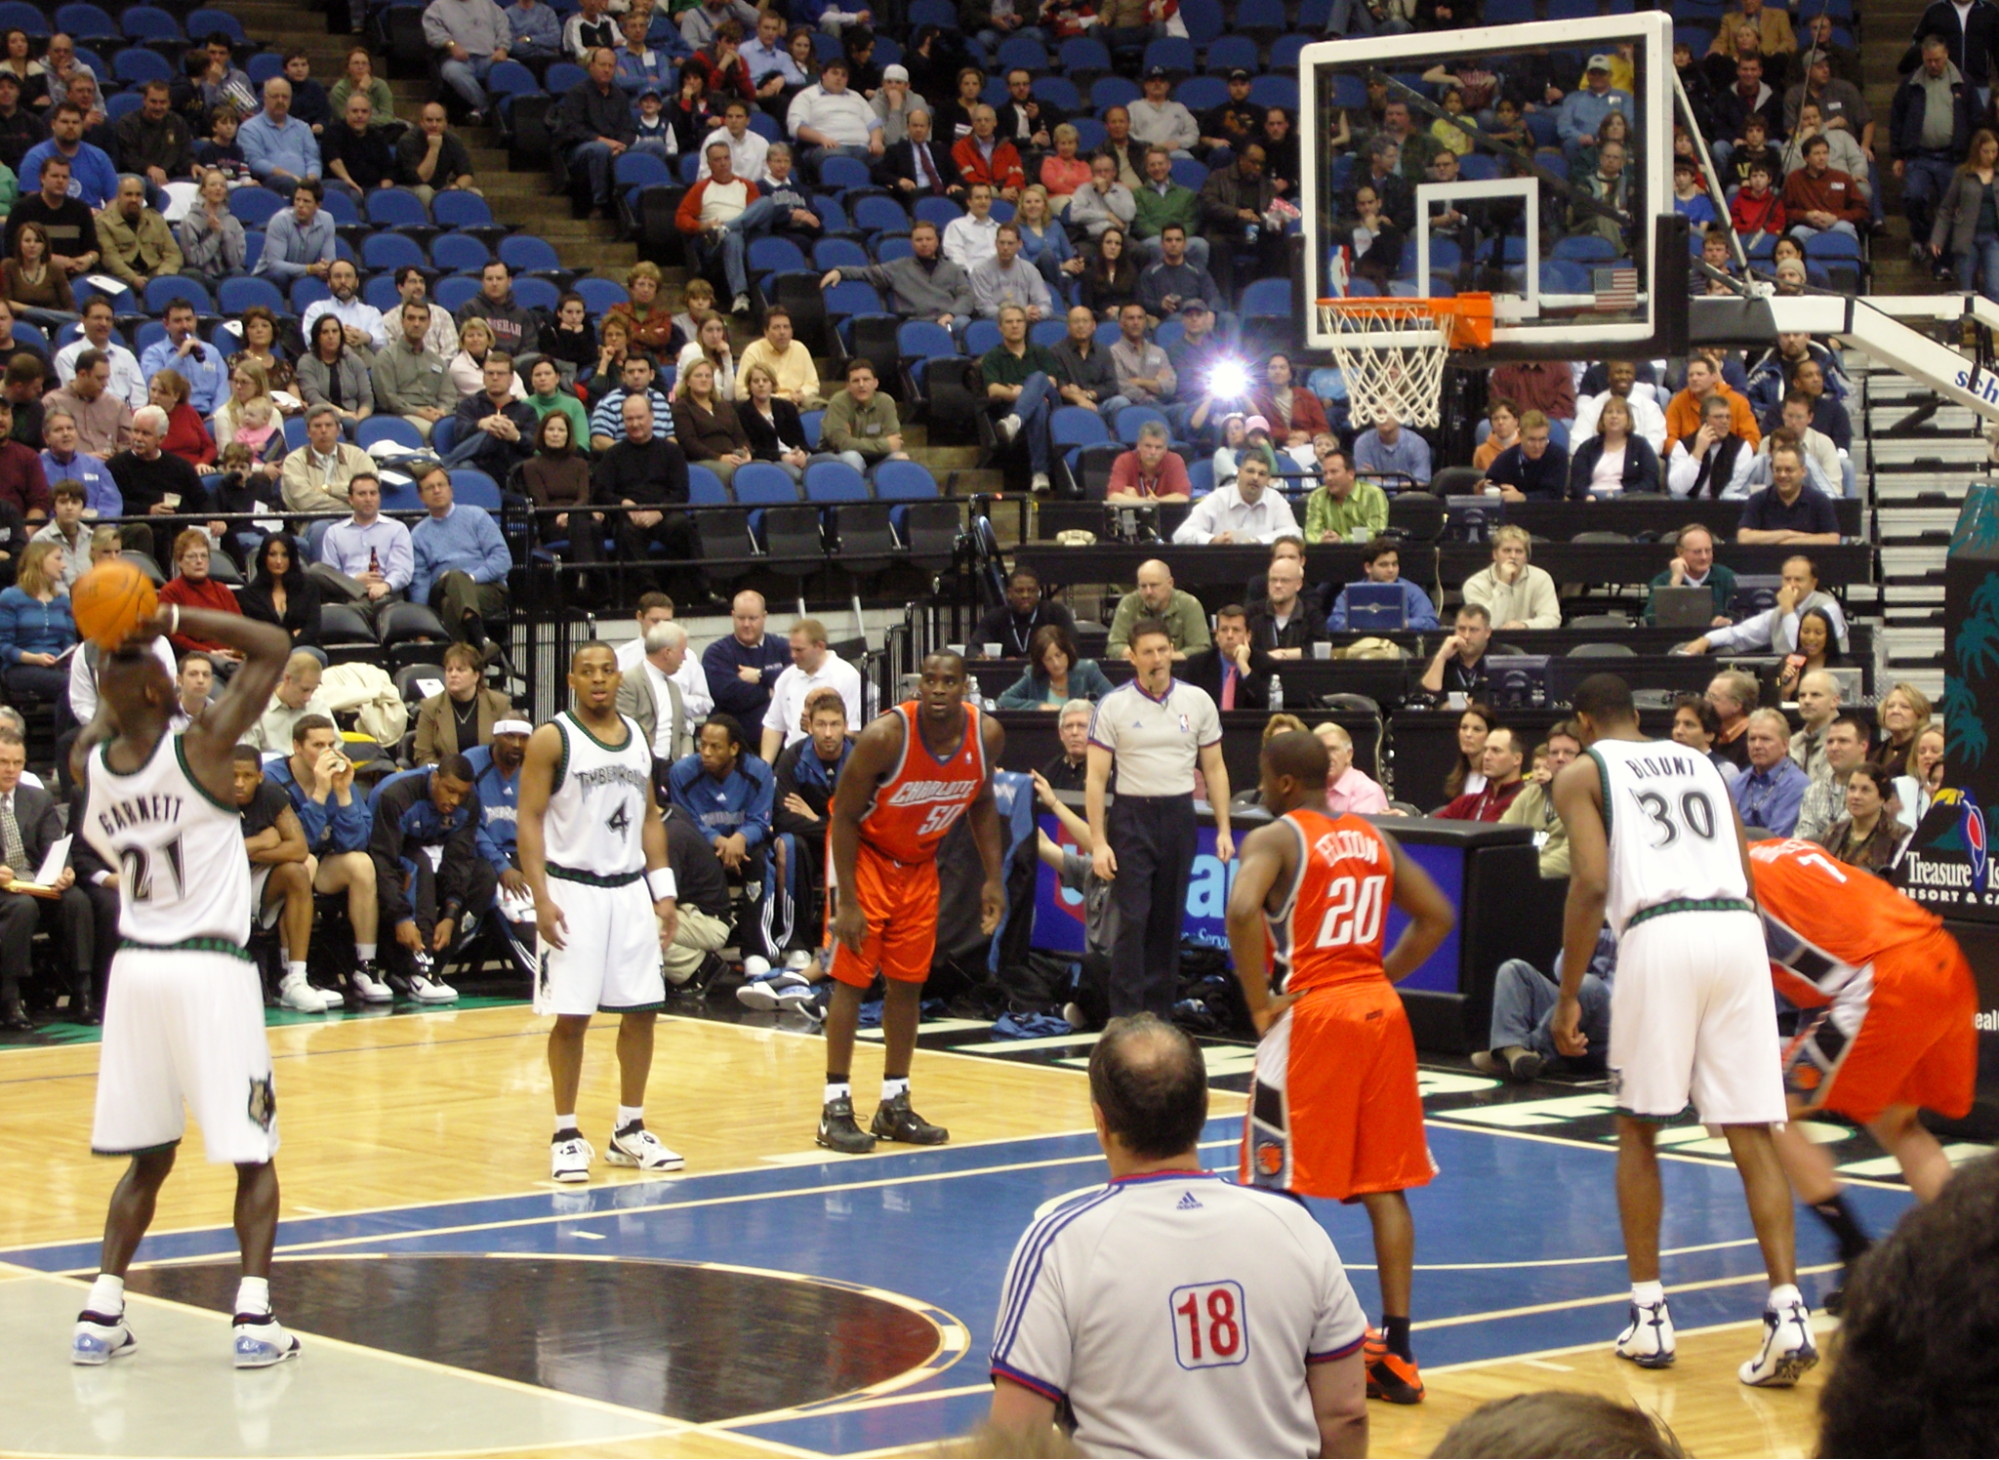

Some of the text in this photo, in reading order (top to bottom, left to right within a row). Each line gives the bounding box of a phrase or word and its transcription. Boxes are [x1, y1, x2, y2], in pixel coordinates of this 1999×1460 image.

[1624, 755, 1694, 780] BLOUNT
[98, 792, 184, 837] GARNETT
[605, 795, 633, 844] 4
[917, 803, 967, 836] 50
[1626, 786, 1717, 850] 30
[114, 830, 186, 903] 21
[1905, 850, 1972, 888] Treasure
[1315, 874, 1387, 949] 20
[1965, 891, 1978, 905] &
[1176, 1288, 1240, 1360] 18
